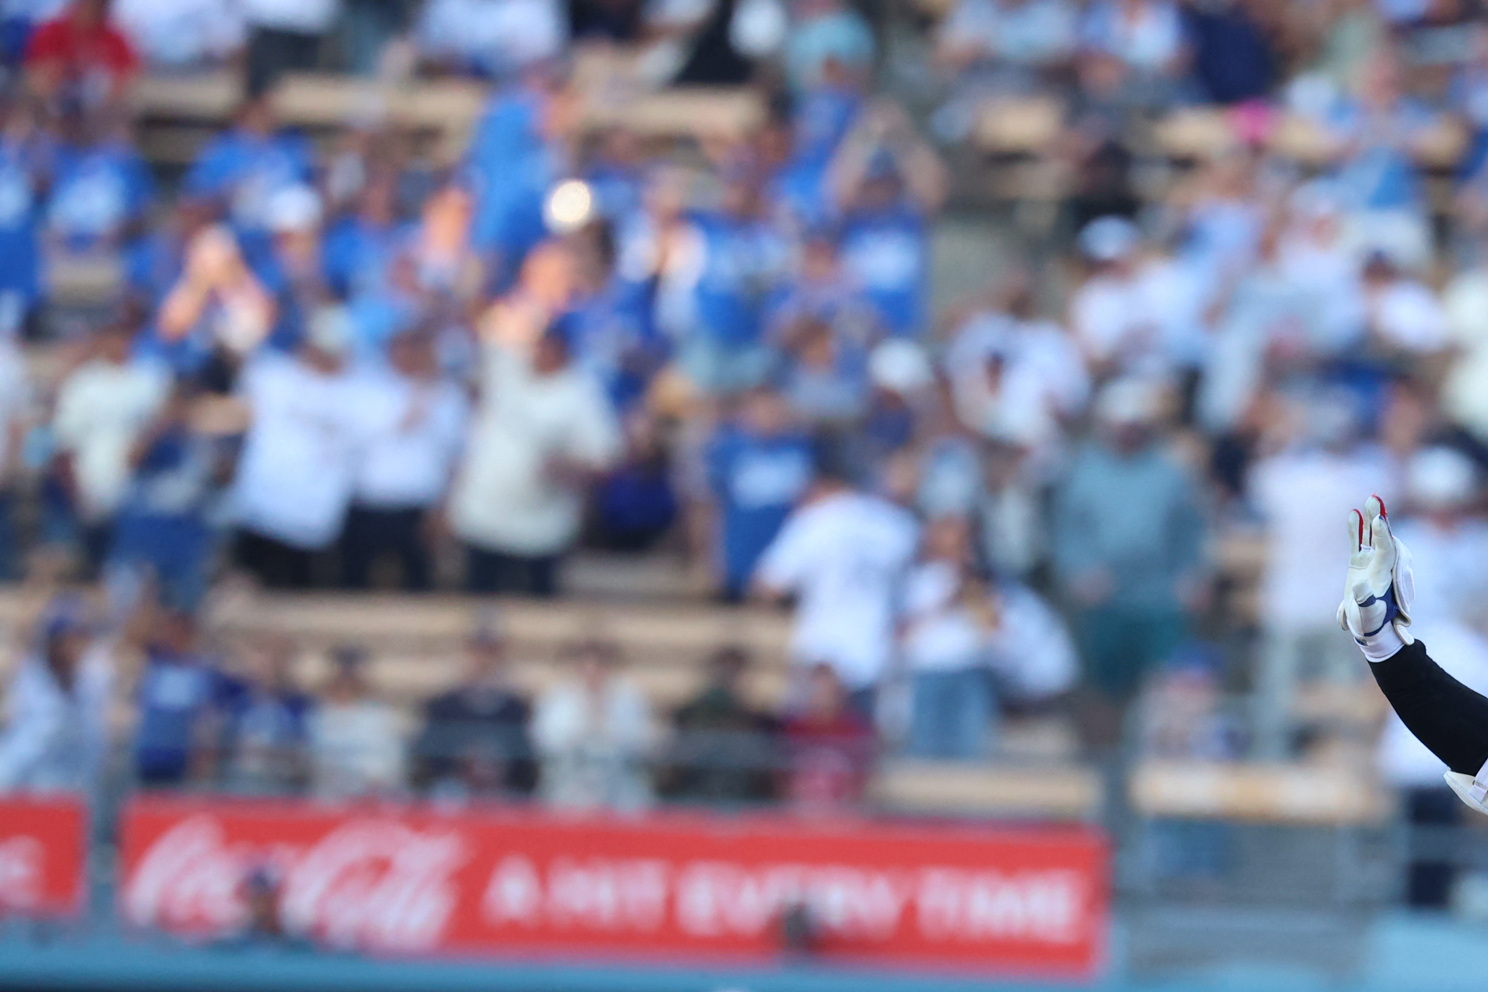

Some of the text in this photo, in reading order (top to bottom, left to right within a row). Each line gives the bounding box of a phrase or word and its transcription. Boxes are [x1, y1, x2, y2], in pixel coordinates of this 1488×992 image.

[122, 812, 474, 952] Coc-Cola
[480, 853, 546, 930] A
[546, 856, 672, 932] HIT
[913, 866, 1086, 946] TIME
